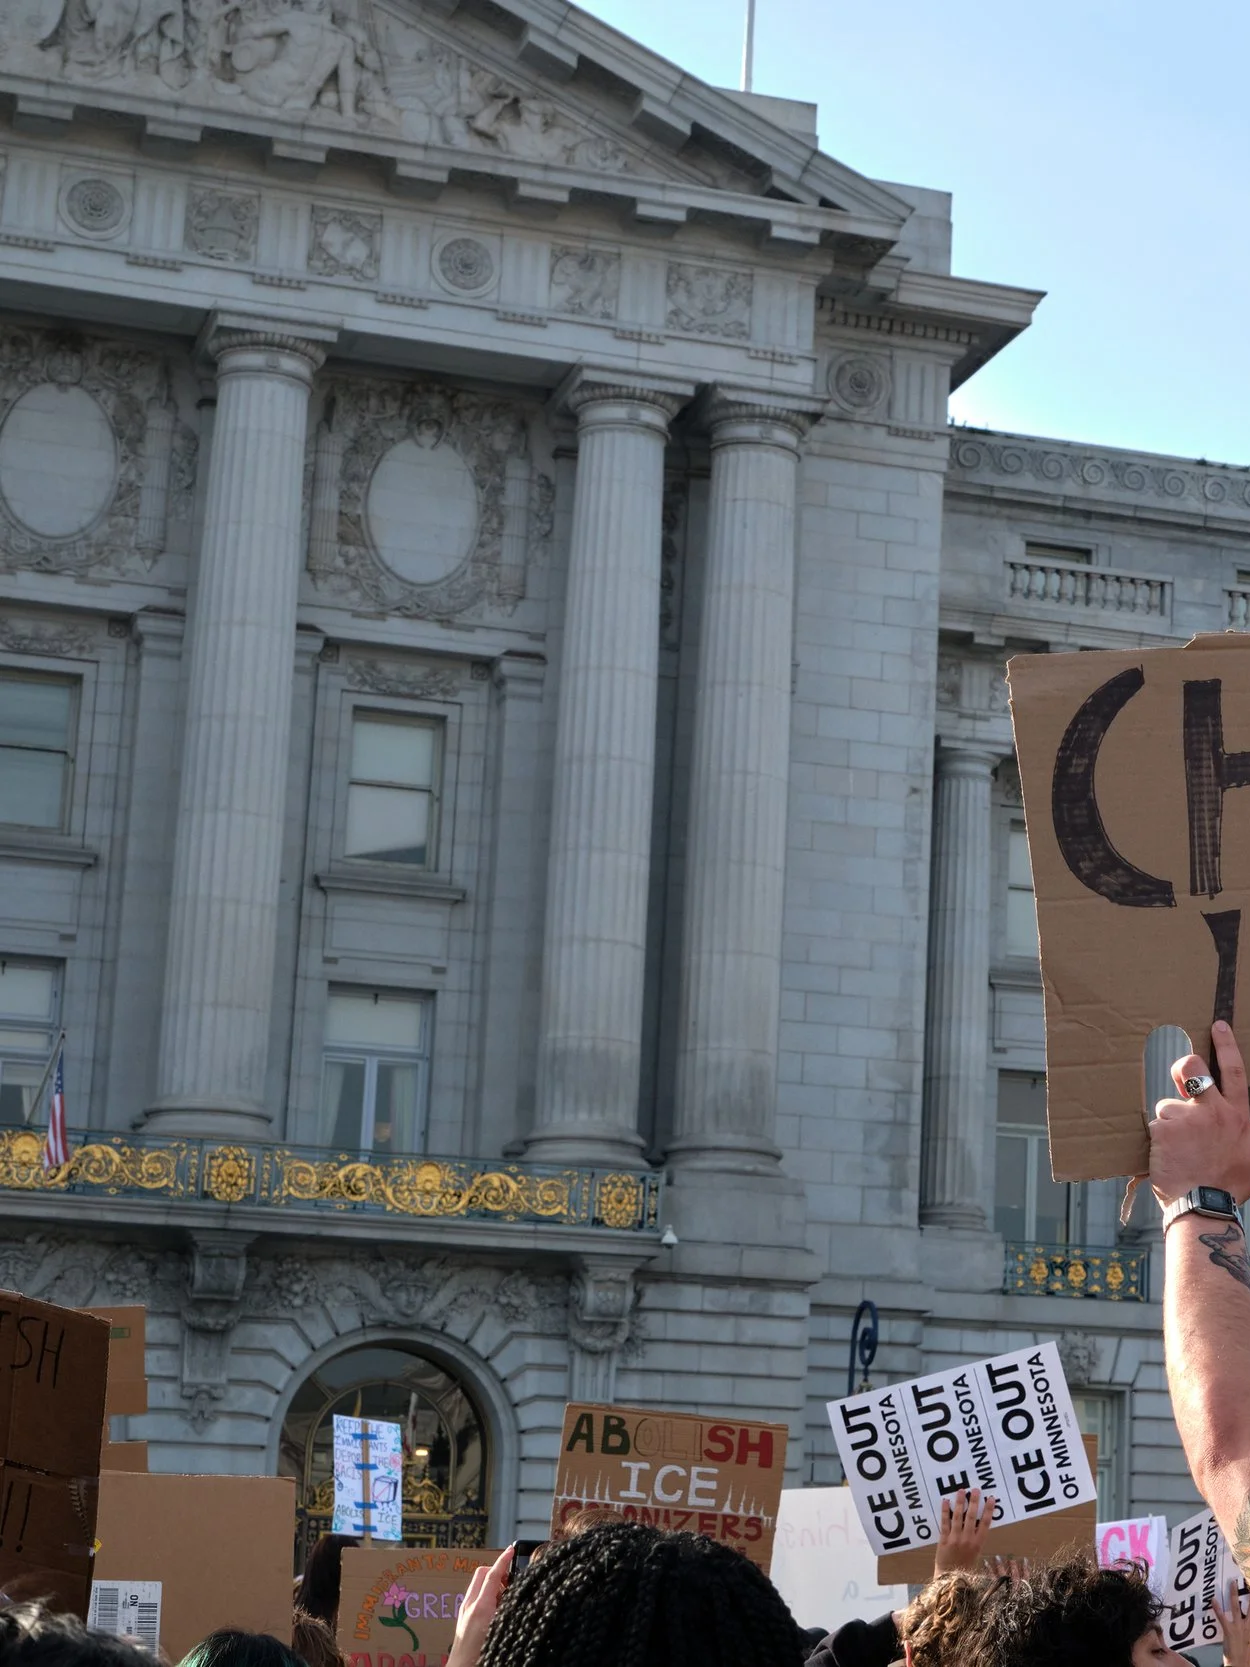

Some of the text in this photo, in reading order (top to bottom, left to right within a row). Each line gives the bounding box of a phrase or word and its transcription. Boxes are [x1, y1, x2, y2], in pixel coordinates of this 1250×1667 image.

[0, 1310, 65, 1389] SH
[334, 1435, 388, 1452] IMMIGANTS
[335, 1448, 362, 1463] DEPOR
[566, 1413, 774, 1469] ABOLISH
[840, 1404, 887, 1481] OUT
[911, 1384, 960, 1463] OUT
[952, 1373, 997, 1490] MINNESOTA
[985, 1363, 1057, 1513] ICE OUT
[1027, 1351, 1079, 1500] OF MINNESOTA
[334, 1462, 363, 1480] RACIS
[619, 1461, 720, 1507] ICE
[879, 1393, 931, 1540] OF MINNESOTA
[335, 1504, 364, 1518] ABOLIS
[560, 1501, 763, 1542] CONIZERS
[868, 1489, 911, 1550] ICE
[354, 1552, 448, 1641] IMMIGRANTS
[1169, 1523, 1202, 1651] ICE OUT
[1202, 1615, 1217, 1640] OF
